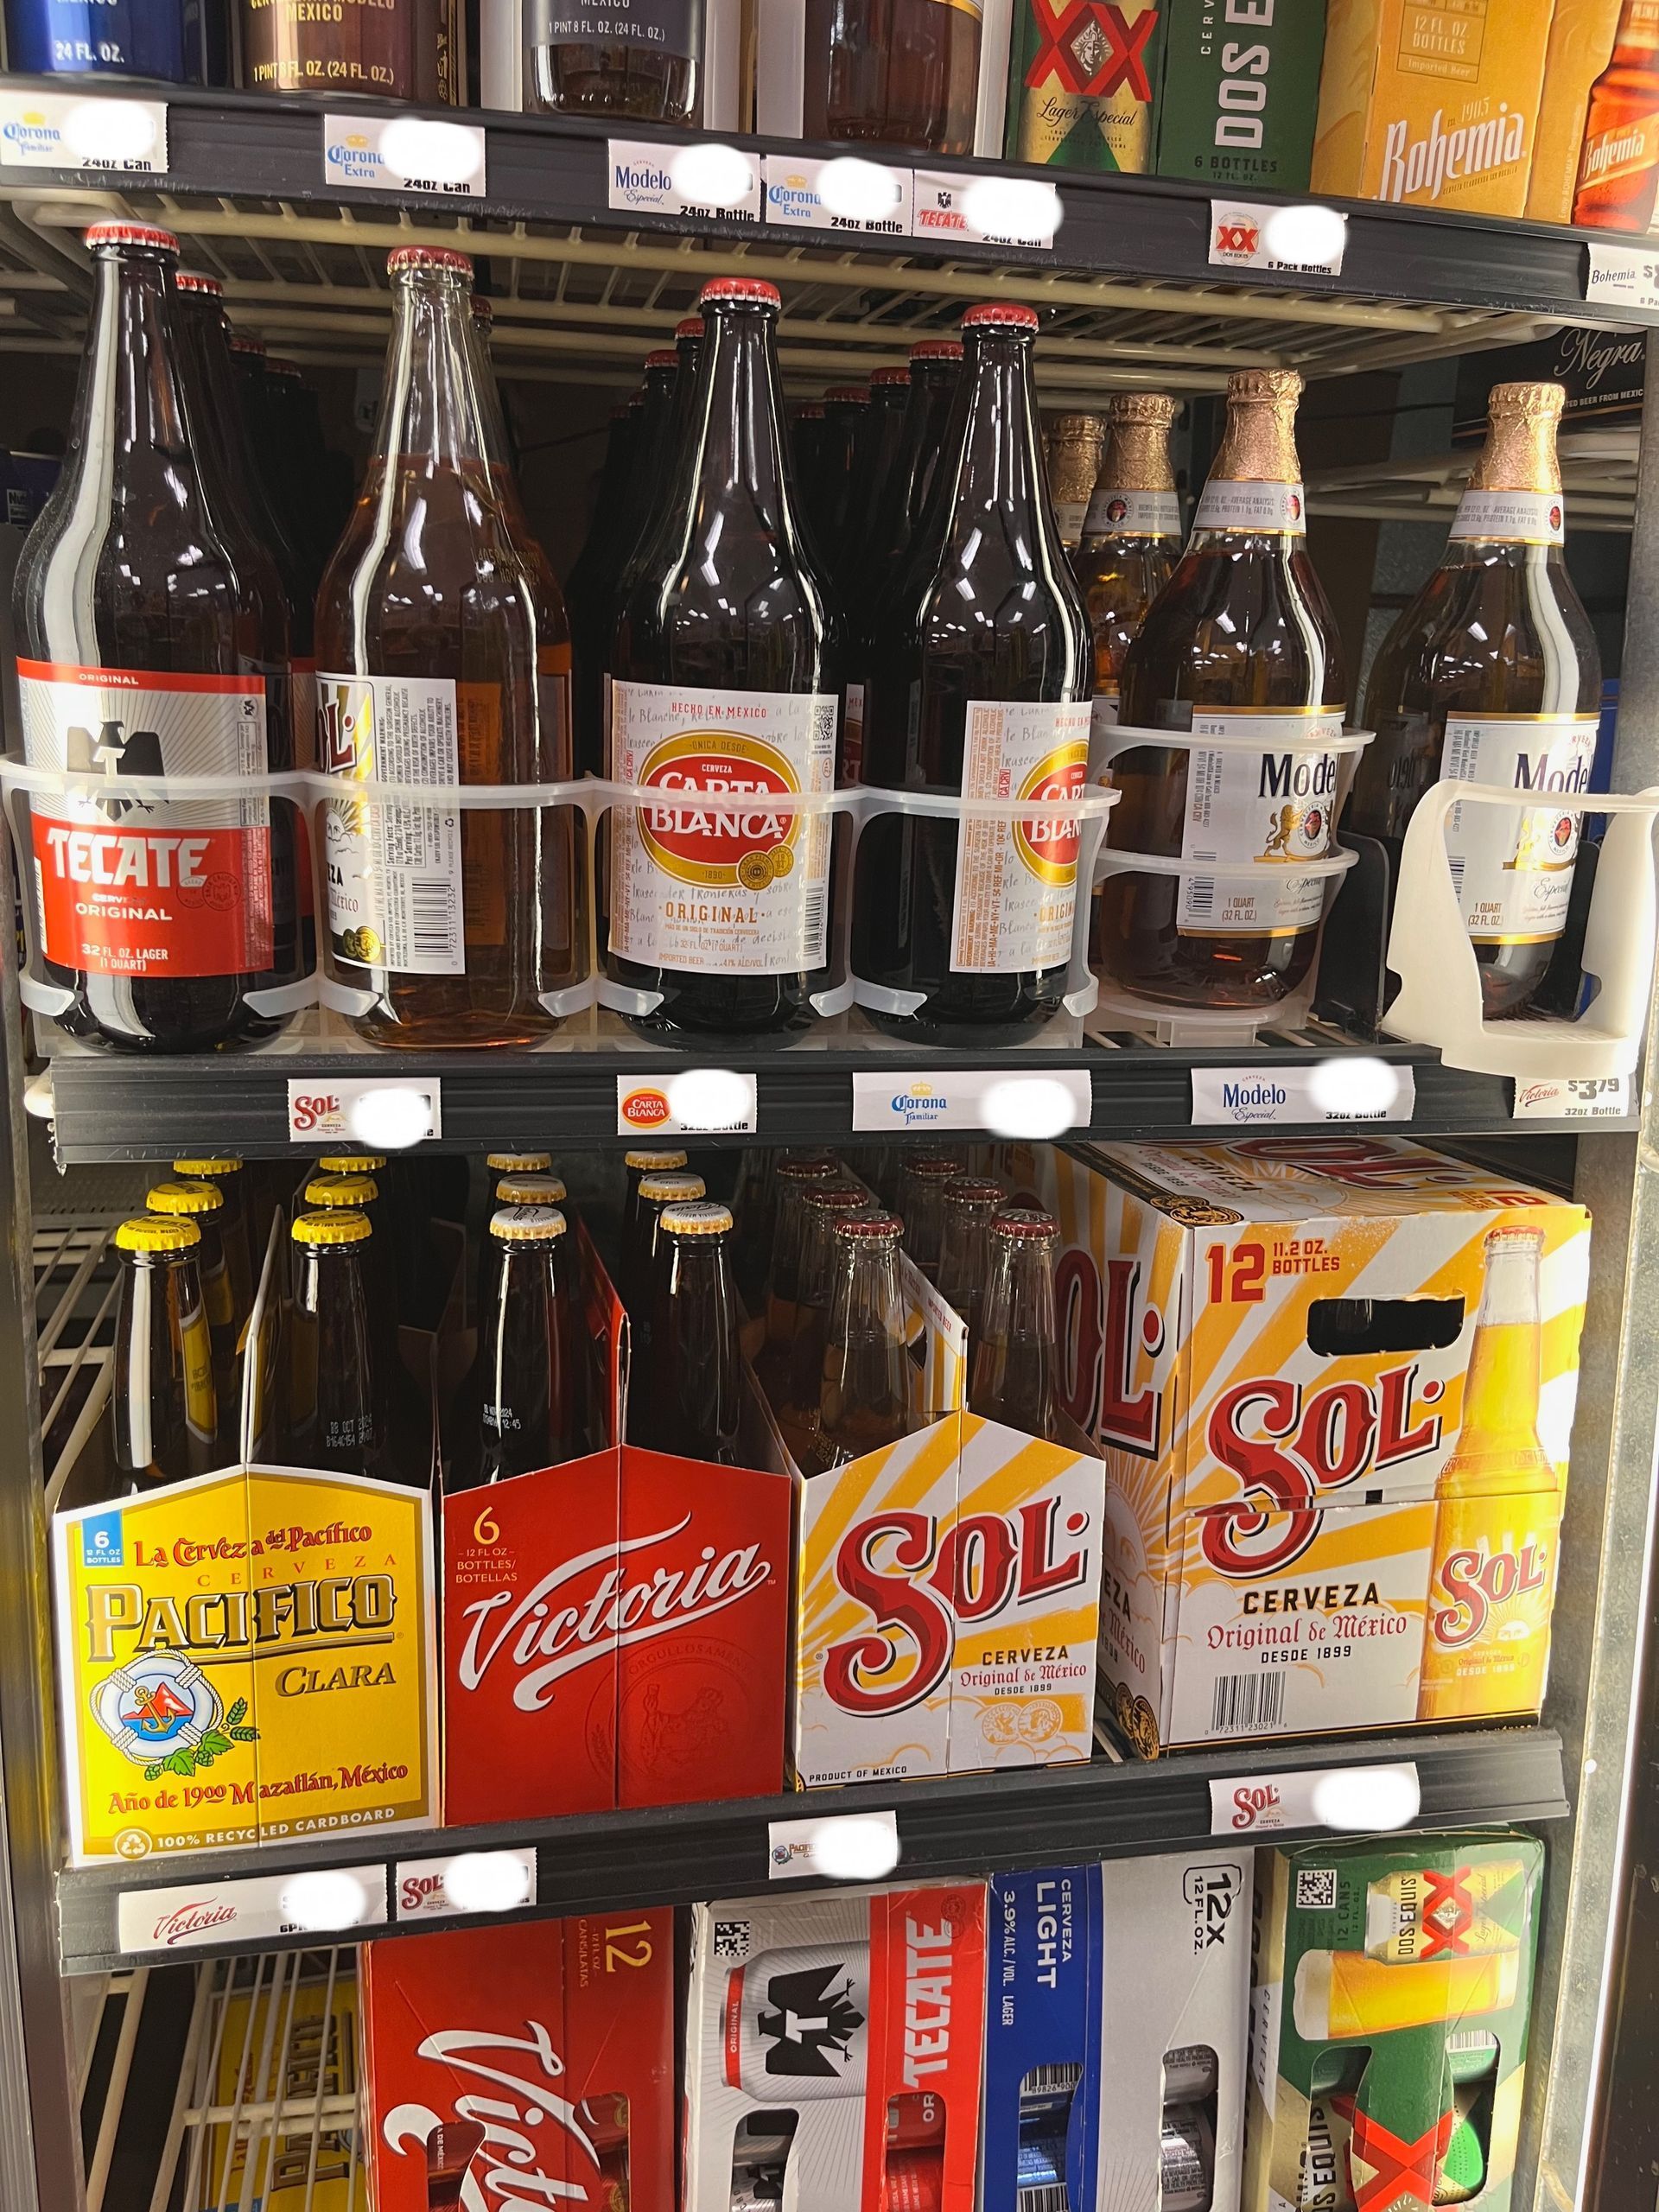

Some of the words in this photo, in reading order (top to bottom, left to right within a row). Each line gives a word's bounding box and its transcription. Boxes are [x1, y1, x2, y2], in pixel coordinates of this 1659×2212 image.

[286, 2, 342, 22] MEXICO
[554, 22, 572, 33] PINT
[574, 22, 579, 33] 8
[582, 22, 594, 33] FL.
[598, 22, 613, 34] OZ.
[615, 23, 629, 35] (24
[632, 25, 645, 38] FL.
[648, 27, 665, 41] OZ.)
[55, 41, 73, 60] 24
[76, 41, 97, 61] FL.
[100, 42, 124, 63] OZ.
[1413, 33, 1466, 54] BOTTLES
[259, 65, 277, 81] PINT
[287, 61, 303, 77] FL.
[306, 60, 325, 76] OZ.
[327, 60, 346, 78] (24
[351, 62, 367, 79] FL.
[371, 65, 394, 85] OZ.)
[1215, 43, 1269, 148] DOS
[1037, 97, 1080, 128] Lager
[1081, 101, 1138, 126] Especial
[3, 122, 60, 142] Corona
[1374, 102, 1524, 202] Bohemia
[1580, 129, 1645, 180] Bohemia
[345, 164, 375, 178] Extra
[1194, 156, 1202, 168] 6
[1211, 156, 1277, 173] BOTTLES
[404, 178, 437, 191] 24oz
[615, 165, 671, 190] Modelo
[624, 189, 664, 205] Especial
[784, 205, 811, 218] Extra
[917, 208, 968, 230] TECATE
[830, 216, 860, 230] 24oz
[866, 219, 902, 233] Bottle
[1217, 226, 1258, 252] XX
[1277, 261, 1298, 270] Pack
[1301, 264, 1332, 274] Bottles
[1592, 268, 1636, 284] Bohemia
[1554, 327, 1642, 390] Negra
[1580, 396, 1598, 406] BEER
[1599, 392, 1619, 404] FROM
[79, 673, 138, 685] ORIGINAL
[672, 702, 702, 715] HECHO
[709, 705, 721, 715] EN
[702, 764, 733, 773] CERVEZA
[649, 803, 784, 839] BLANCA
[48, 826, 211, 887] TECATE
[704, 870, 722, 880] 1890
[75, 902, 173, 921] ORIGINAL
[447, 887, 456, 914] 13232
[1233, 898, 1255, 907] QUART
[1480, 902, 1502, 913] QUART
[665, 901, 758, 924] ORIGINAL
[1222, 910, 1233, 921] (32
[81, 943, 100, 957] 32
[103, 945, 118, 958] FL.
[120, 946, 135, 959] OZ.
[137, 948, 168, 961] LAGER
[689, 955, 704, 965] BEER
[110, 958, 146, 971] QUART)
[632, 1099, 664, 1109] CARTA
[891, 1095, 947, 1113] Corona
[1224, 1084, 1286, 1107] Modelo
[1519, 1082, 1559, 1107] Victoria
[294, 1095, 340, 1131] SOL
[628, 1107, 665, 1117] BLANCA
[905, 1113, 938, 1125] Familiar
[1231, 1107, 1274, 1122] Especial
[1565, 1108, 1588, 1116] 32oz
[1592, 1107, 1621, 1116] Bottle
[1205, 1242, 1266, 1305] 12
[1273, 1242, 1299, 1258] 11.2
[1303, 1237, 1328, 1257] OZ.
[1273, 1255, 1340, 1274] BOTTLES
[1200, 1362, 1446, 1580] SOL
[473, 1506, 501, 1545] 6
[94, 1530, 109, 1548] 6
[135, 1541, 168, 1568] La
[174, 1535, 264, 1567] Cerveza
[266, 1529, 287, 1549] del
[287, 1520, 372, 1554] Pacífico
[86, 1555, 122, 1564] BOTTLES
[467, 1548, 475, 1557] 12
[478, 1548, 491, 1556] FL
[493, 1547, 508, 1556] OZ
[197, 1554, 397, 1587] CERVEZA
[457, 1558, 516, 1571] BOTTLES/
[455, 1571, 518, 1585] BOTELLAS
[1243, 1581, 1381, 1615] CERVEZA
[1434, 1542, 1548, 1647] SOL
[86, 1573, 398, 1662] PACIFICO
[459, 1510, 772, 1713] Victoria
[823, 1495, 1090, 1718] SOL
[1206, 1621, 1303, 1652] Original
[1308, 1620, 1326, 1641] de
[1335, 1612, 1408, 1639] México
[982, 1644, 1069, 1667] CERVEZA
[1261, 1648, 1312, 1664] DESDE
[1316, 1643, 1352, 1661] 1899
[275, 1662, 397, 1698] CLARA
[960, 1669, 1020, 1688] Original
[1024, 1669, 1036, 1681] de
[1039, 1662, 1087, 1681] México
[1456, 1664, 1488, 1676] DESDE
[995, 1684, 1027, 1695] DESDE
[1029, 1682, 1052, 1693] 1899
[1219, 1724, 1244, 1734] 72311
[1249, 1722, 1274, 1732] 23021
[810, 1768, 852, 1783] PRODUCT
[856, 1769, 869, 1778] OF
[872, 1766, 907, 1777] MEXICO
[108, 1790, 150, 1814] Año
[156, 1789, 177, 1808] de
[183, 1784, 226, 1808] 1900
[229, 1773, 339, 1804] Mazatlán,
[337, 1762, 409, 1789] México
[1232, 1783, 1280, 1830] SOL
[157, 1833, 200, 1848] 100%
[206, 1822, 294, 1846] RECYCLED
[296, 1807, 396, 1832] CARDBOARD
[401, 1873, 444, 1910] SOL
[1194, 1875, 1204, 1894] 12
[1206, 1872, 1233, 1948] 12X
[1338, 1880, 1351, 1921] CANS
[1399, 1877, 1416, 1923] EQUIS
[153, 1895, 238, 1945] Victoria
[1003, 1890, 1016, 1934] 3.9%
[1061, 1878, 1072, 1963] CERVEZA
[1037, 1881, 1058, 1988] LIGHT
[1338, 1927, 1349, 1942] 12
[1398, 1928, 1415, 1955] DOS
[606, 1920, 652, 1973] 12
[904, 1916, 953, 2088] TECATE
[1002, 1995, 1014, 2026] LAGER
[730, 2001, 740, 2053] ORIGINAL
